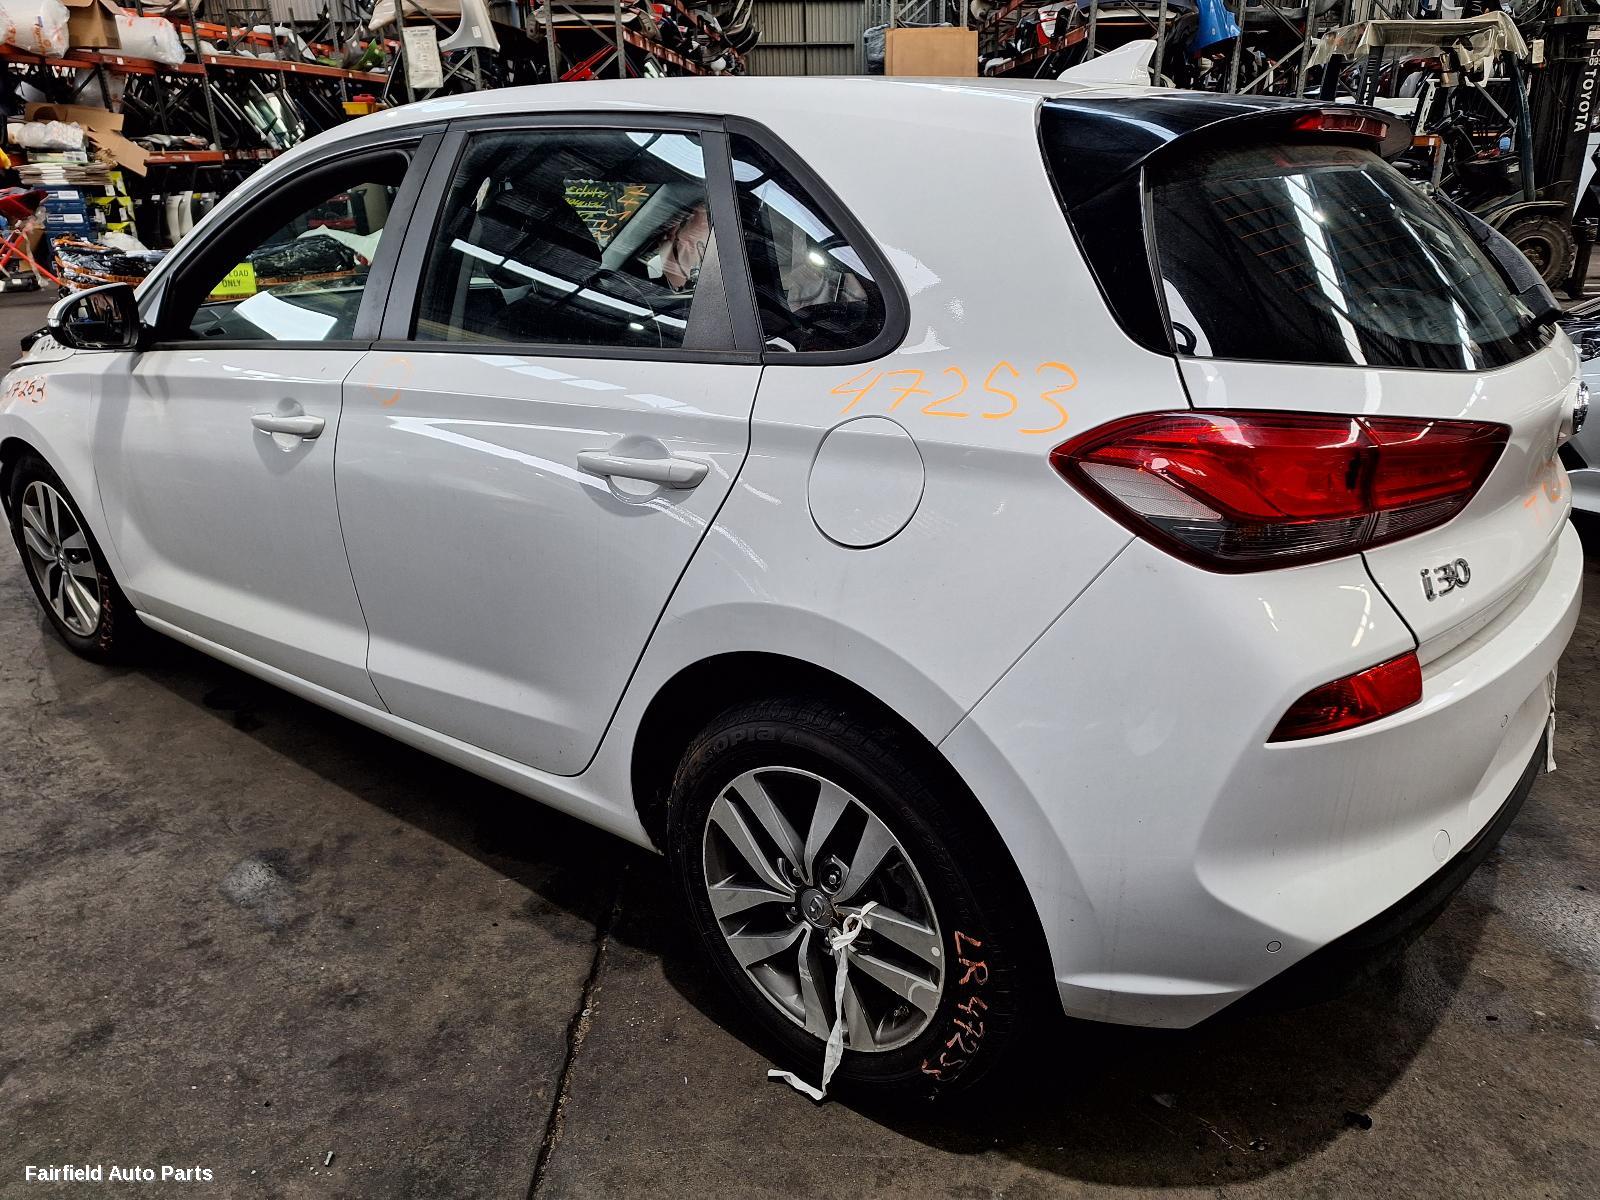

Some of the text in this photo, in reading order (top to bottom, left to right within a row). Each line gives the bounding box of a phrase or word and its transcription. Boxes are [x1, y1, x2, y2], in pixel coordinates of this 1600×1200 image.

[1573, 68, 1598, 133] TOYOTA
[221, 279, 241, 288] ONLY
[830, 360, 1079, 434] 47253
[1420, 557, 1471, 602] i30
[954, 930, 989, 986] LR
